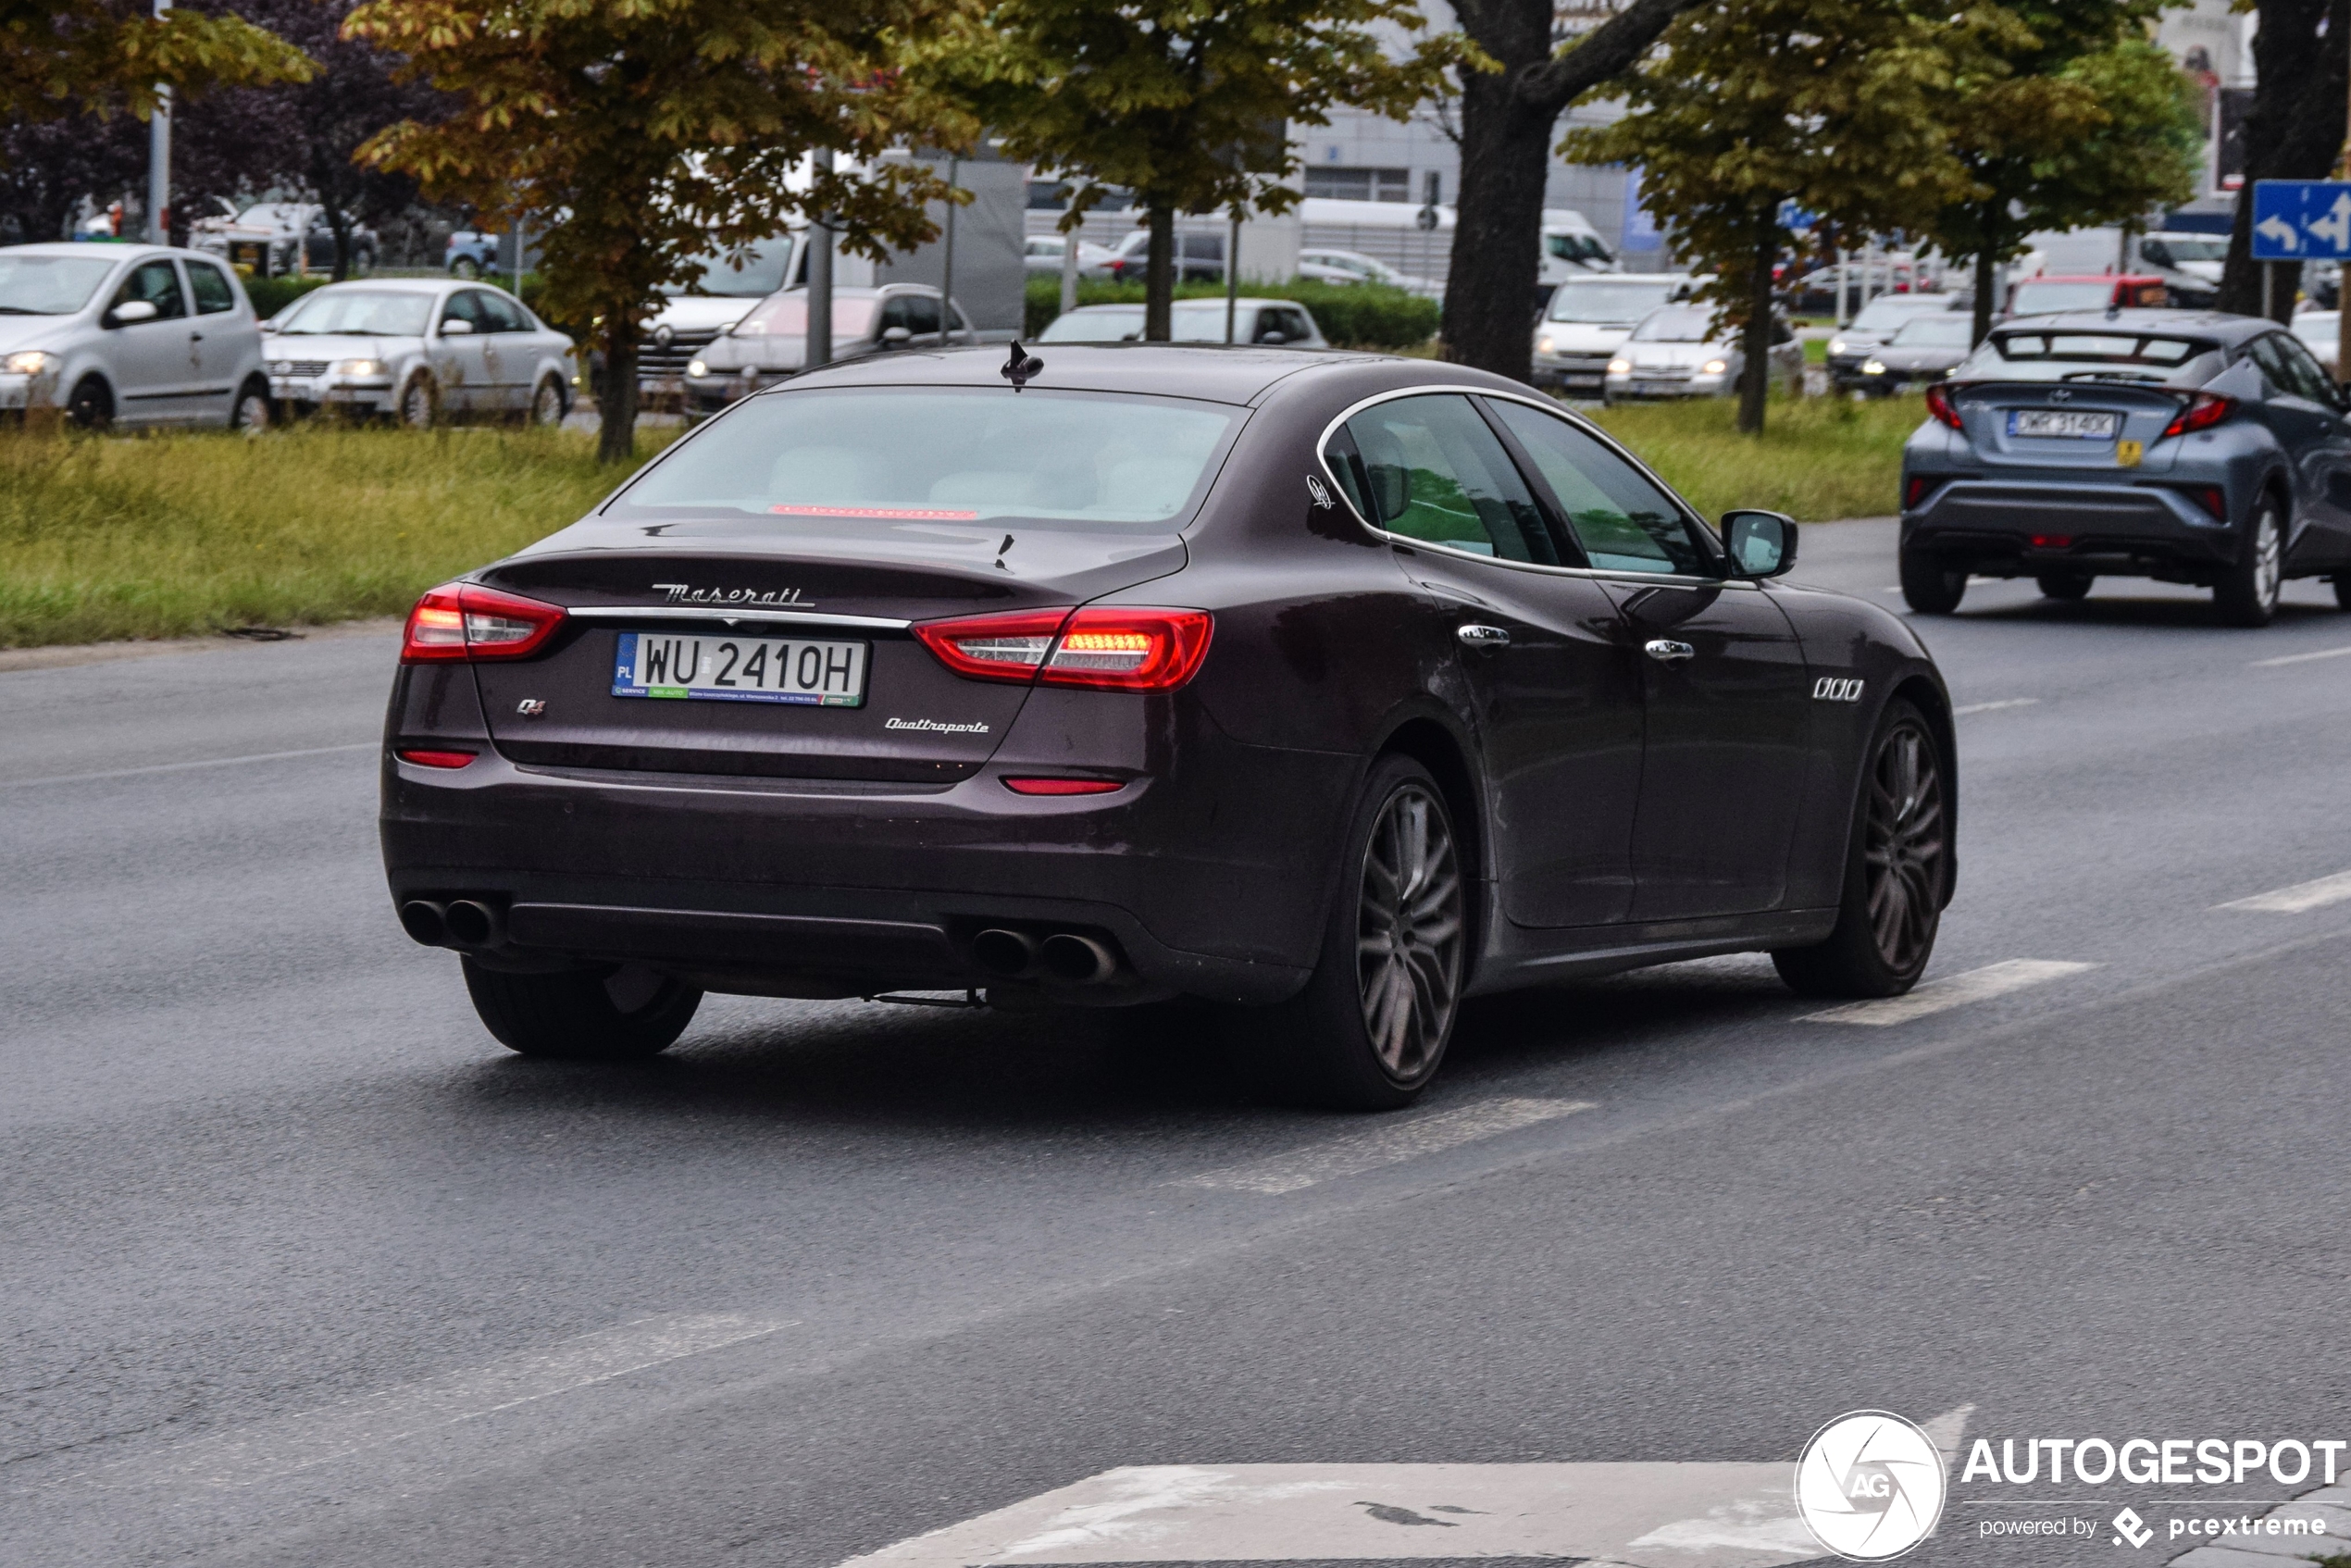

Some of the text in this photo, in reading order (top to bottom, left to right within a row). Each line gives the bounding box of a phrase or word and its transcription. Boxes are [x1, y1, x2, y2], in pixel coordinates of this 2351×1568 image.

[652, 584, 815, 607] Maserati
[616, 666, 632, 678] PL
[645, 640, 852, 691] WU 2410H
[516, 699, 545, 716] Q4
[885, 717, 989, 734] Quattroporte
